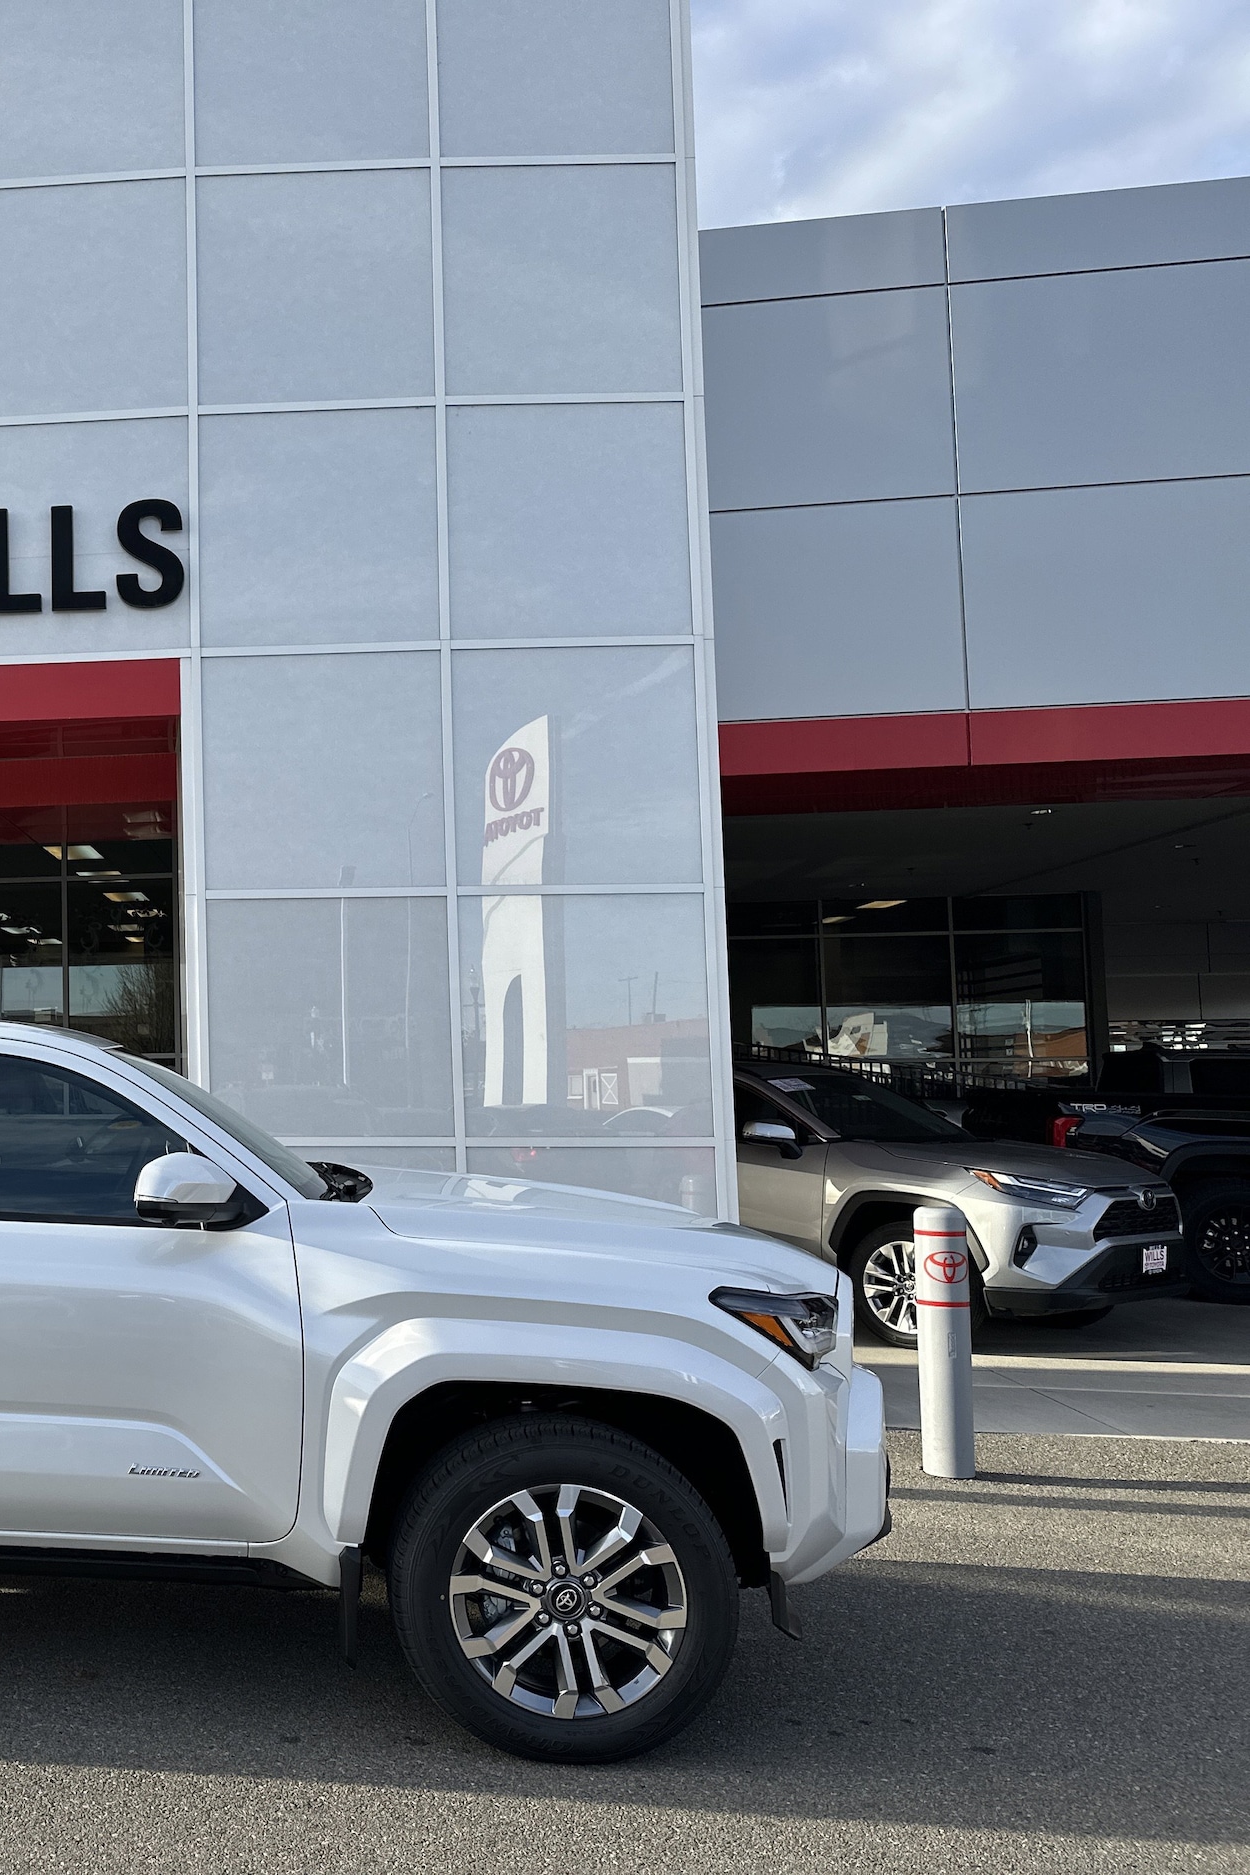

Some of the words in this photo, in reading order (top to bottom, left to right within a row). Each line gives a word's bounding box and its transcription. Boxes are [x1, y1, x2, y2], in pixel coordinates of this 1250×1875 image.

[1070, 1103, 1107, 1112] TRD
[1144, 1250, 1165, 1262] WILLS
[609, 1464, 712, 1561] DUNLOP
